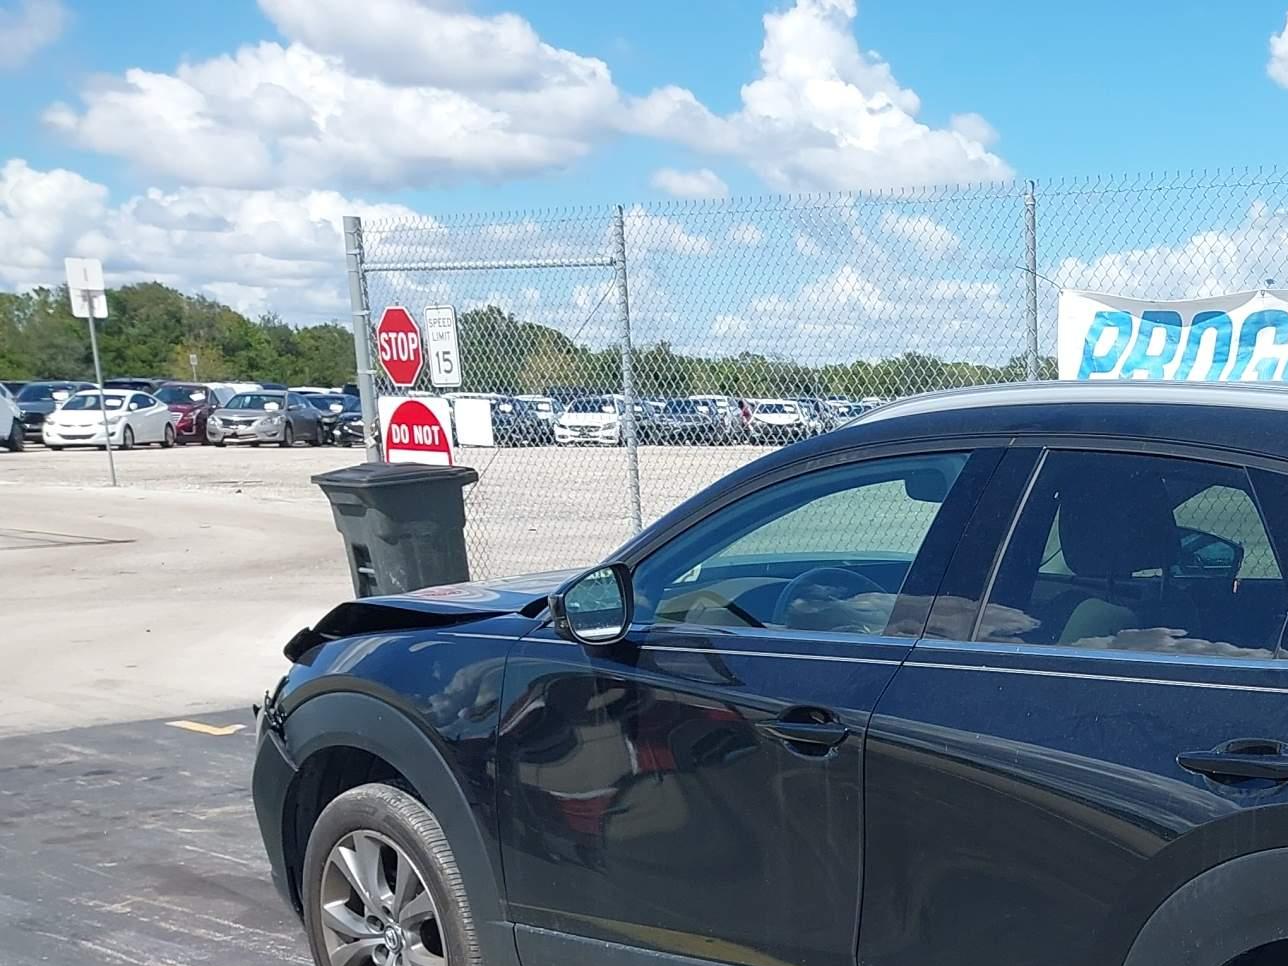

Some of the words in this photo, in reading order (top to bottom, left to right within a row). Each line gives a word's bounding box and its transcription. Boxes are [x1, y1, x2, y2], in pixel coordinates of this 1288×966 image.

[428, 317, 452, 328] SPEED
[380, 331, 418, 361] STOP
[432, 331, 450, 341] LIMIT
[435, 350, 453, 374] 15
[391, 423, 410, 444] DO
[413, 425, 440, 445] NOT
